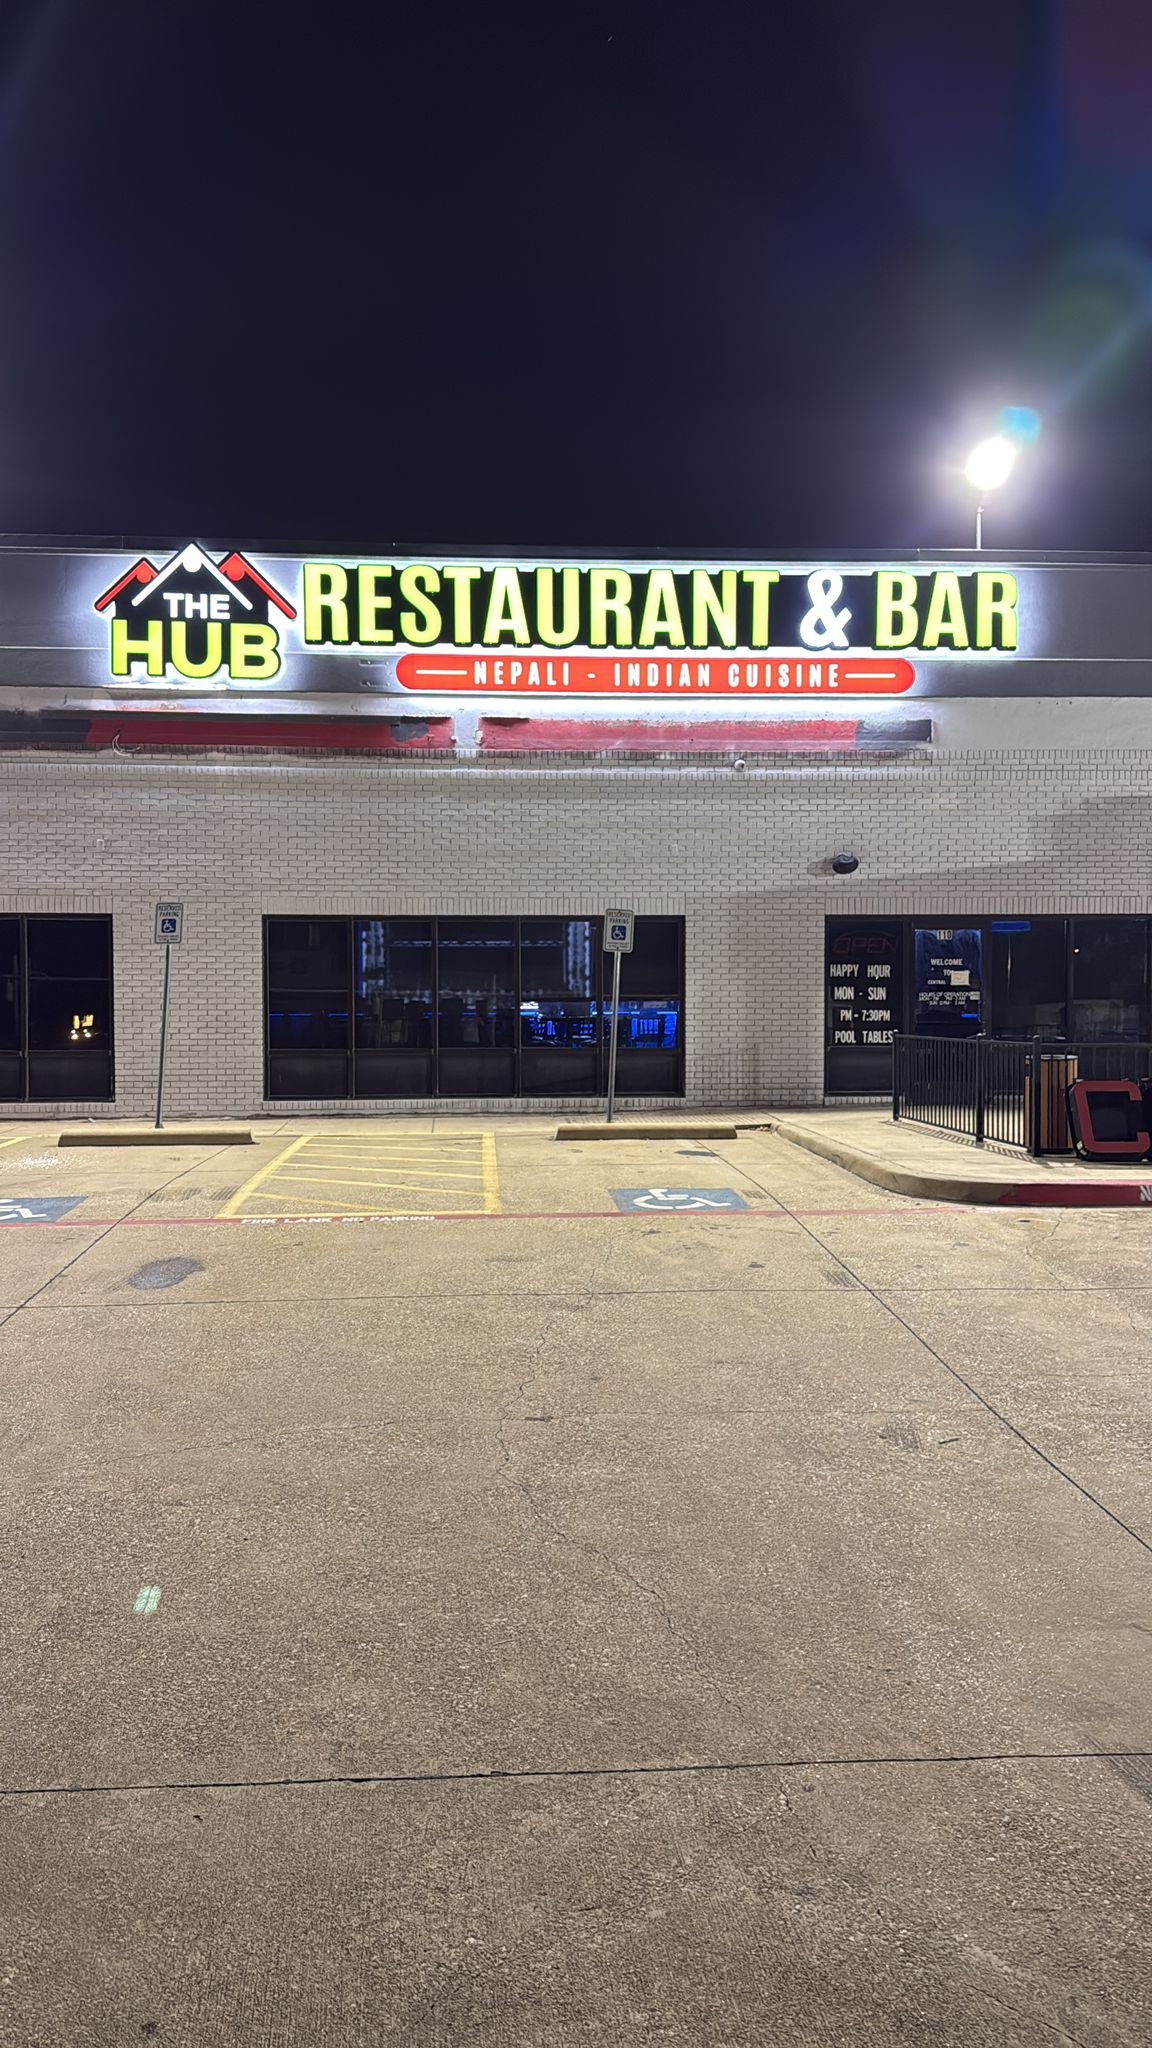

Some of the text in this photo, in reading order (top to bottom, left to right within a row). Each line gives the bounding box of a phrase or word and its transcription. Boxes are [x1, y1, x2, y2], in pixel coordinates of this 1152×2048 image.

[163, 592, 230, 619] THE
[303, 563, 1018, 651] RESTAURANT & BAR
[112, 617, 281, 680] HUB
[473, 660, 570, 687] NEPALI
[614, 662, 711, 688] INDIAN
[727, 663, 840, 688] CUISINE
[936, 930, 952, 940] 110
[833, 937, 897, 954] OPEN
[930, 958, 963, 966] WELCOME
[830, 964, 891, 978] HAPPY HOUR
[834, 986, 854, 1000] MON
[868, 987, 887, 1001] SUN
[840, 1009, 852, 1021] PM
[862, 1009, 891, 1022] 7:30PM
[834, 1030, 893, 1043] POOL TABLES
